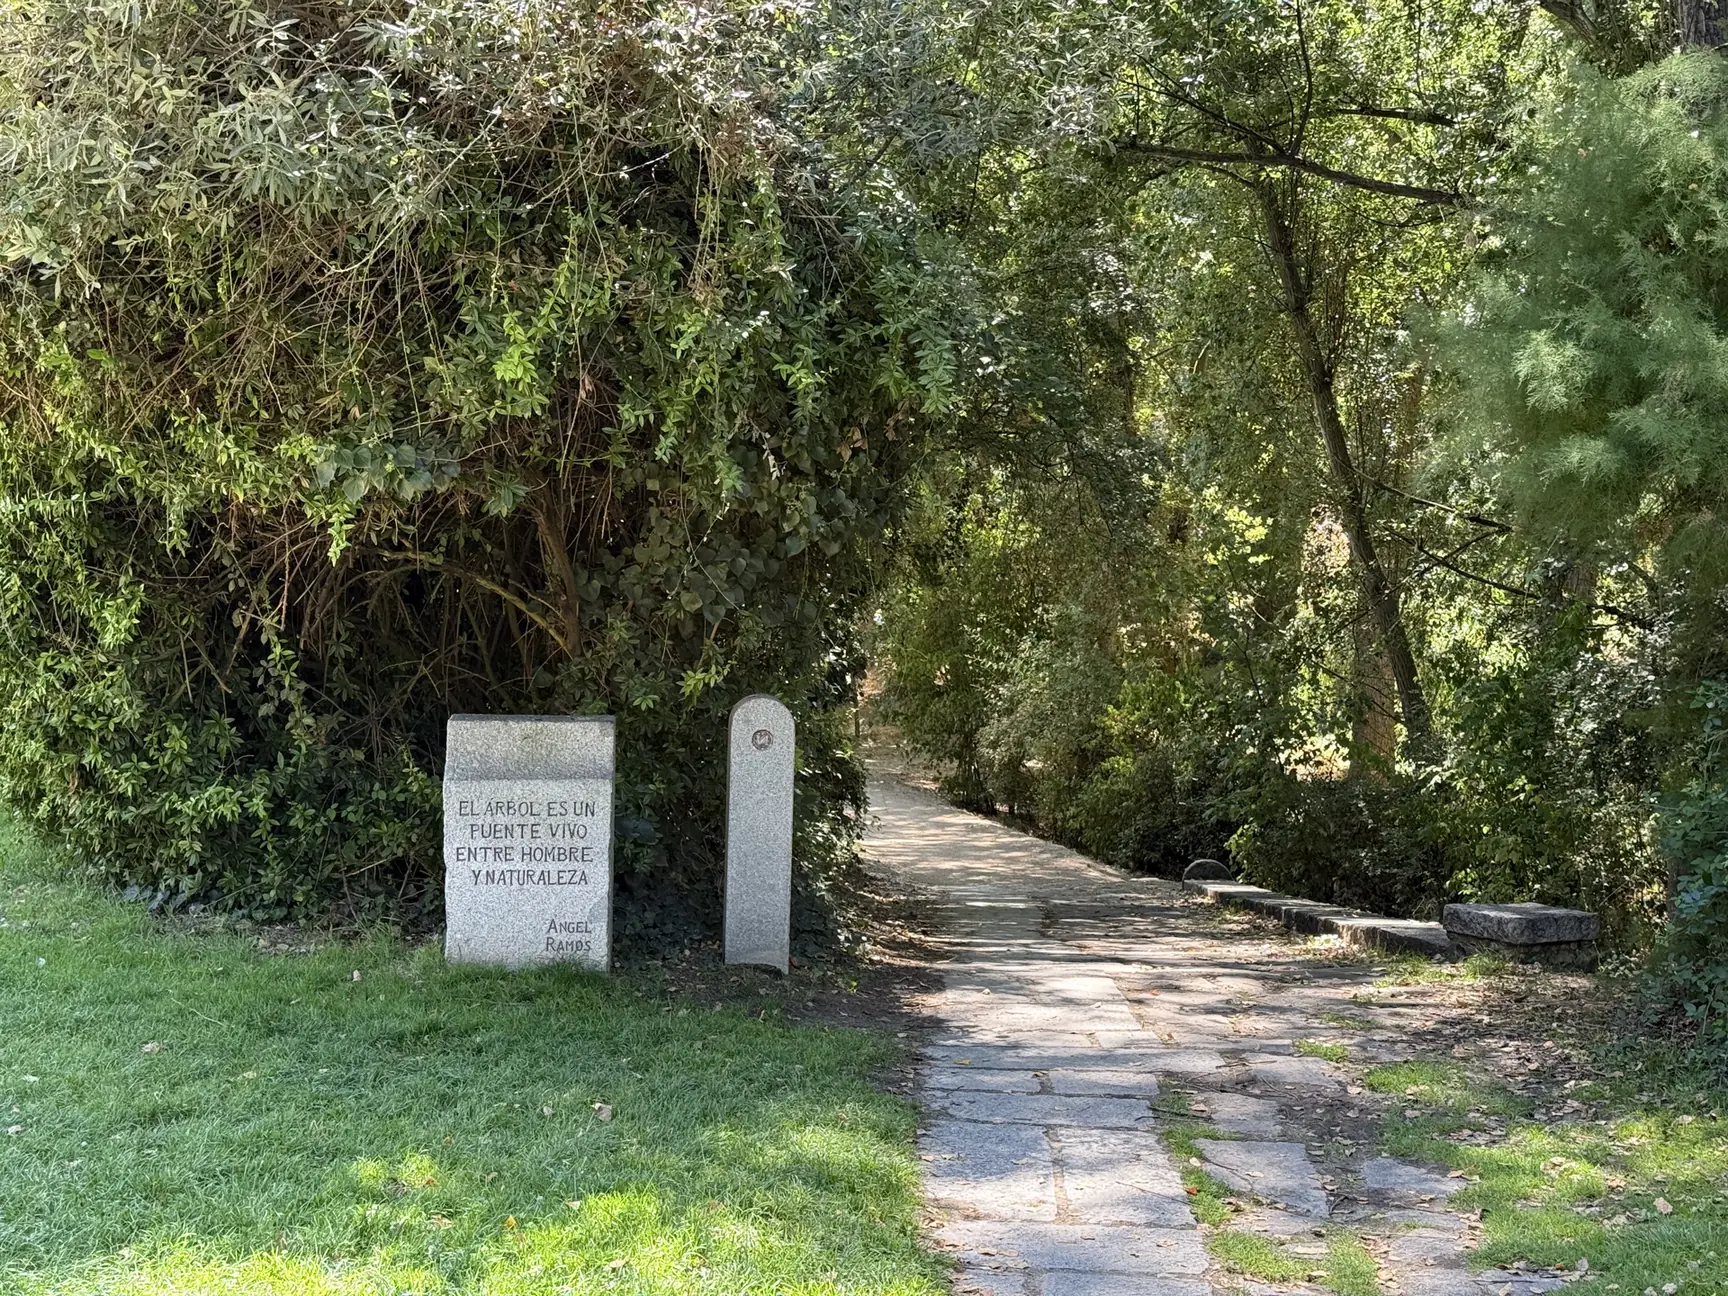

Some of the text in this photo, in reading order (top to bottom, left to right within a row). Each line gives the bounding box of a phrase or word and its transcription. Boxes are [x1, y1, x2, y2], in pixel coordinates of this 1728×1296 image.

[459, 801, 480, 816] EL
[547, 801, 568, 817] ES
[573, 801, 595, 817] UN
[470, 823, 588, 840] PUENTE VIVO
[456, 846, 593, 863] ENTRE HOMBRE
[472, 869, 588, 885] Y NATURALEZA
[546, 936, 592, 952] RAMOS
